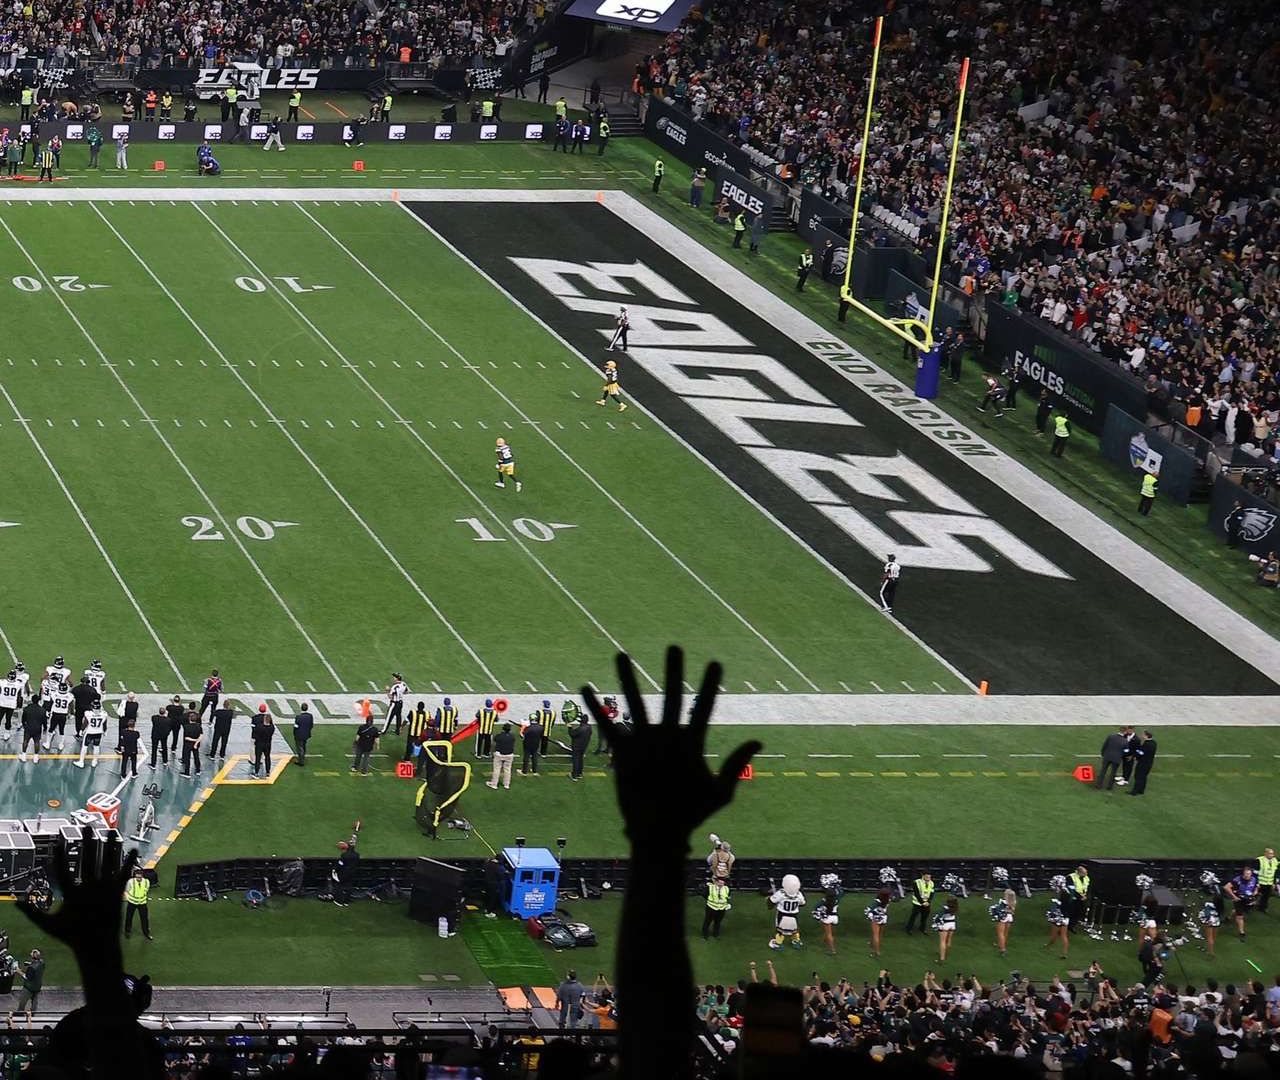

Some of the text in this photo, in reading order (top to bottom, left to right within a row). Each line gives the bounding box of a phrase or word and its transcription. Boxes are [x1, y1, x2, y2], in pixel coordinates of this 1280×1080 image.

[665, 127, 688, 146] EAGLES
[721, 180, 765, 216] EAGLES
[1014, 350, 1065, 396] EAGLES
[806, 341, 999, 458] END RACISM
[508, 255, 1076, 582] EAGLES
[180, 516, 275, 541] 20
[454, 517, 555, 542] 10
[3, 686, 17, 697] 90
[55, 698, 69, 709] 93
[90, 717, 104, 728] 97
[400, 764, 412, 776] 20
[1082, 767, 1090, 780] G
[783, 900, 799, 911] 00
